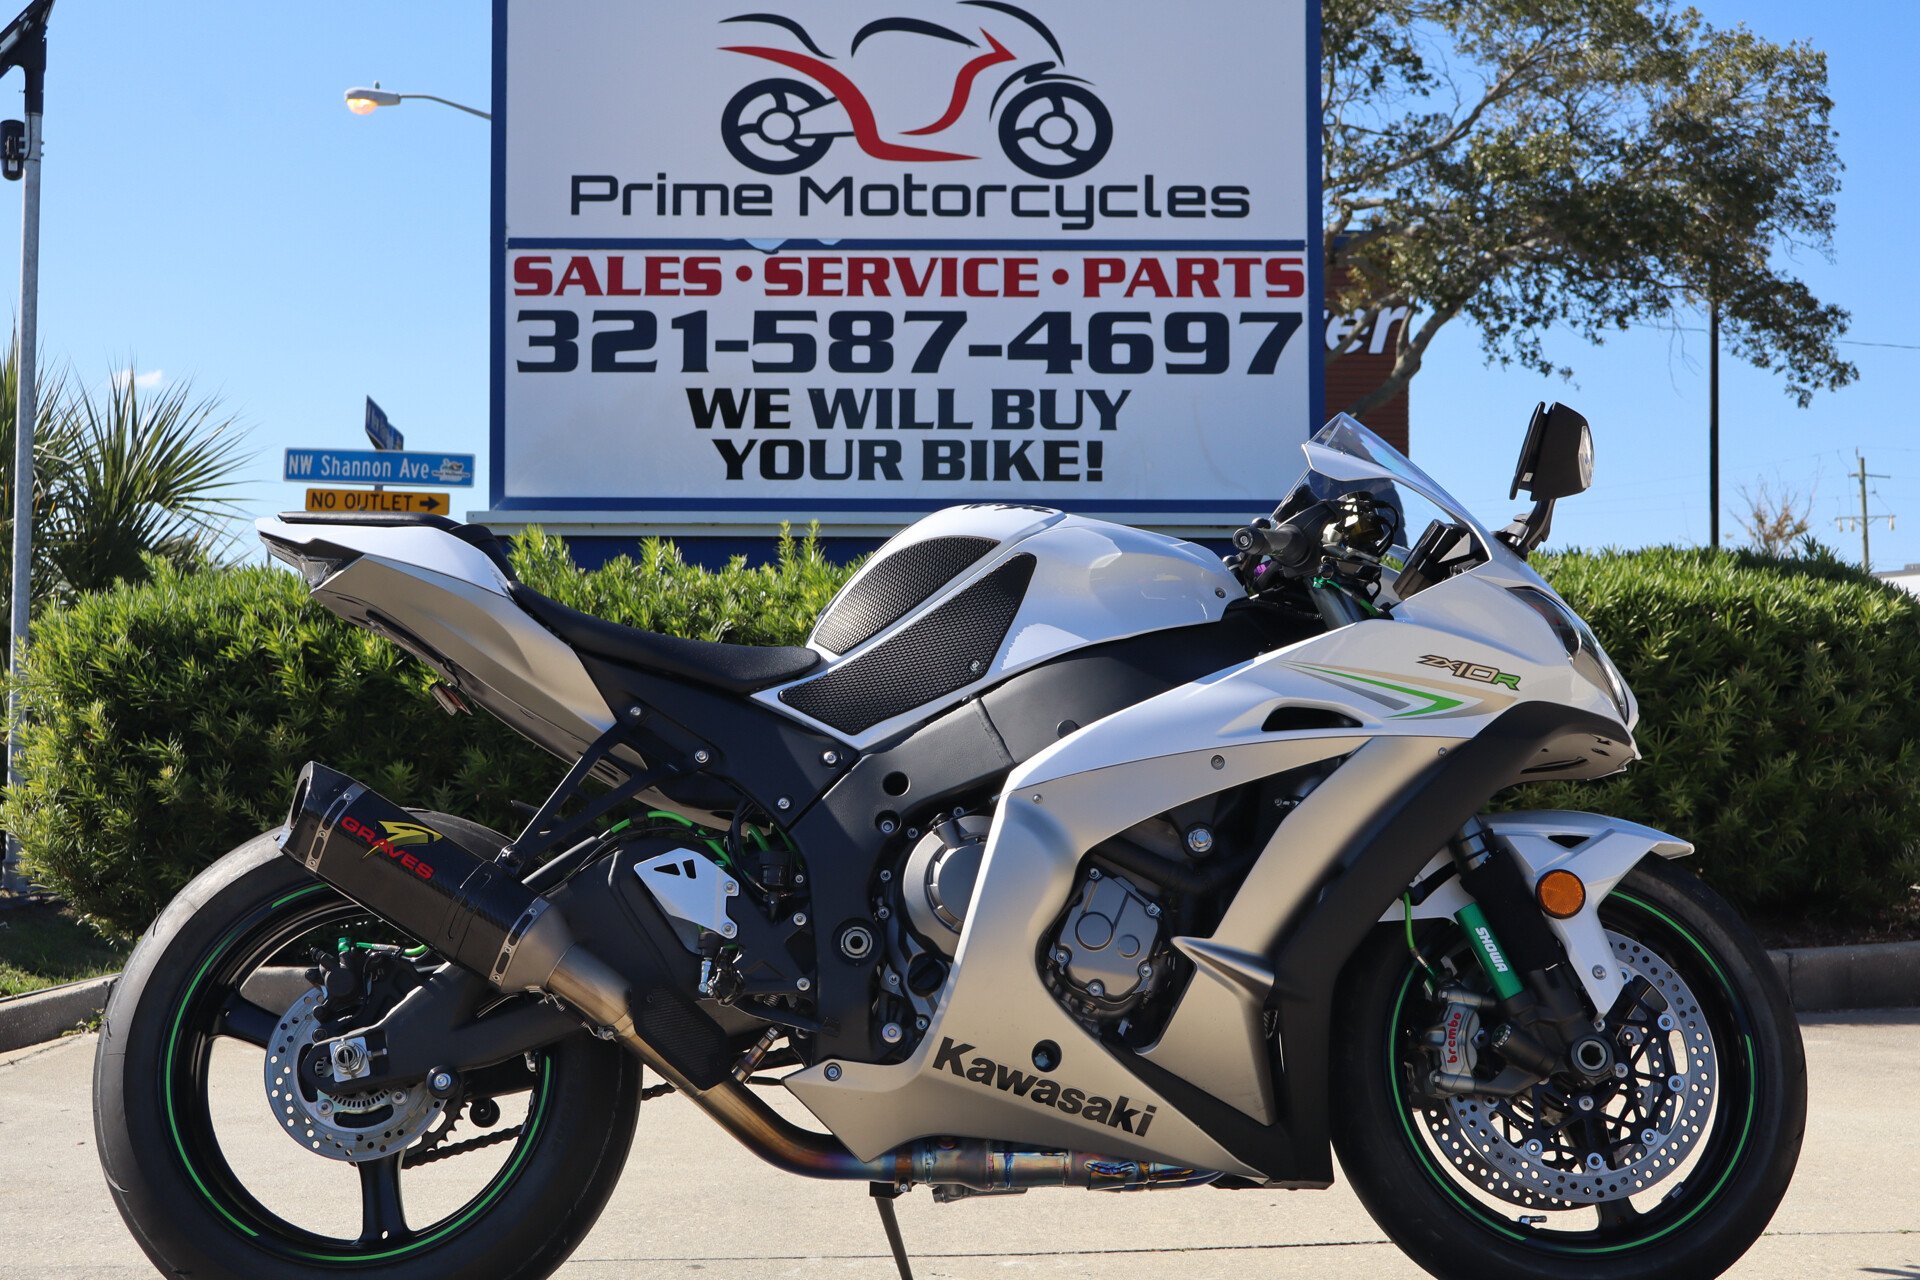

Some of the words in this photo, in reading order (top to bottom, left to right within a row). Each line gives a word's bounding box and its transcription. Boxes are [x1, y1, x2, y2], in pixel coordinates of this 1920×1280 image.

[570, 172, 773, 217] Prime
[799, 173, 1250, 231] Motorcycles
[515, 256, 722, 296] SALES
[765, 257, 1038, 297] SERVICE
[1084, 258, 1304, 298] PARTS
[516, 309, 1303, 375] 321-587-4697
[1323, 305, 1409, 354] er
[685, 387, 791, 430] WE
[807, 388, 974, 430] WILL
[991, 388, 1132, 431] BUY
[288, 454, 313, 475] NW
[320, 454, 392, 478] Shannon
[399, 458, 430, 479] Ave
[711, 438, 904, 481] YOUR
[921, 439, 1103, 482] BIKE!
[311, 491, 336, 509] NO
[344, 492, 413, 511] OUTLET
[340, 816, 435, 880] GRAVES
[1475, 926, 1509, 973] SHOWA
[1447, 1012, 1462, 1064] brembo
[932, 1036, 1158, 1138] Kawasaki
